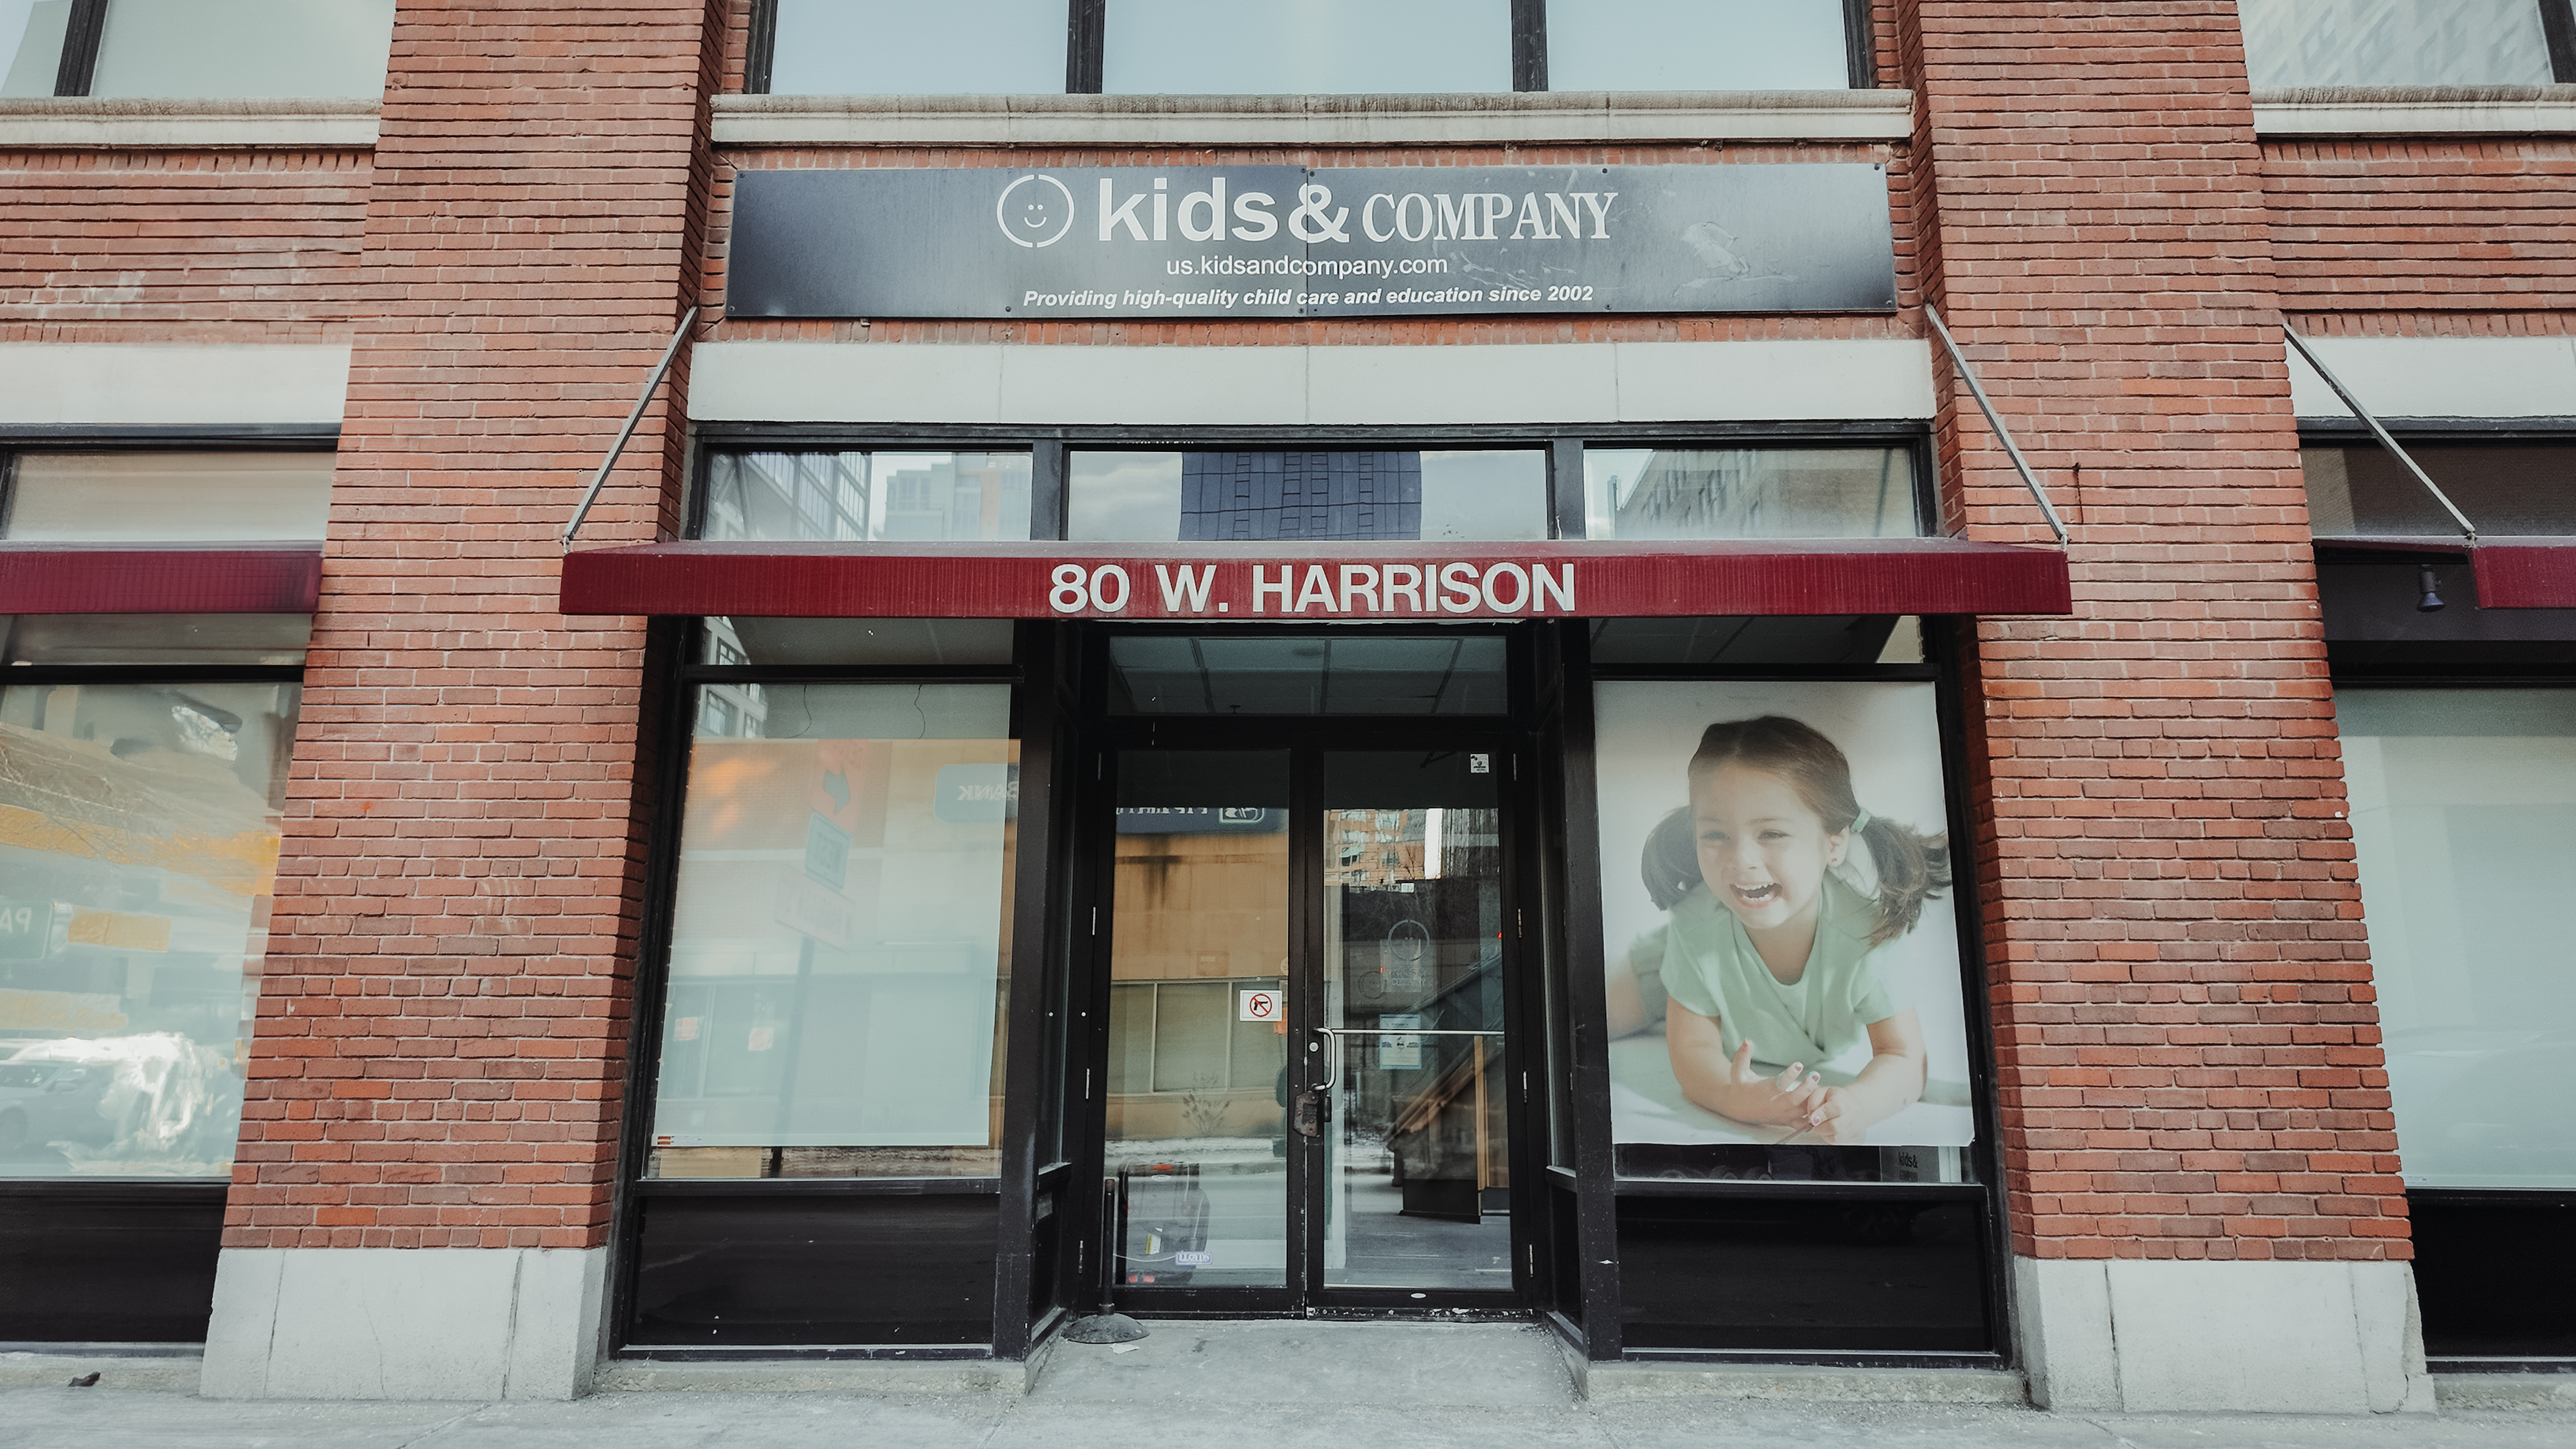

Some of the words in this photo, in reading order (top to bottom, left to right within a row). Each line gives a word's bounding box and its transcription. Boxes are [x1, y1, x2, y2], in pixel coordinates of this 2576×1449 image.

[1362, 192, 1619, 243] COMPANY
[1166, 254, 1448, 280] us.kidsandcompany.com
[1023, 290, 1118, 309] Providing
[1122, 289, 1240, 309] high-quality
[1243, 288, 1293, 305] child
[1296, 291, 1339, 305] care
[1344, 288, 1382, 304] and
[1386, 286, 1483, 303] education
[1488, 286, 1542, 301] since
[1547, 286, 1593, 301] 2002
[1049, 564, 1130, 613] 80
[1155, 565, 1229, 612] W.
[1253, 563, 1575, 613] HARRISON
